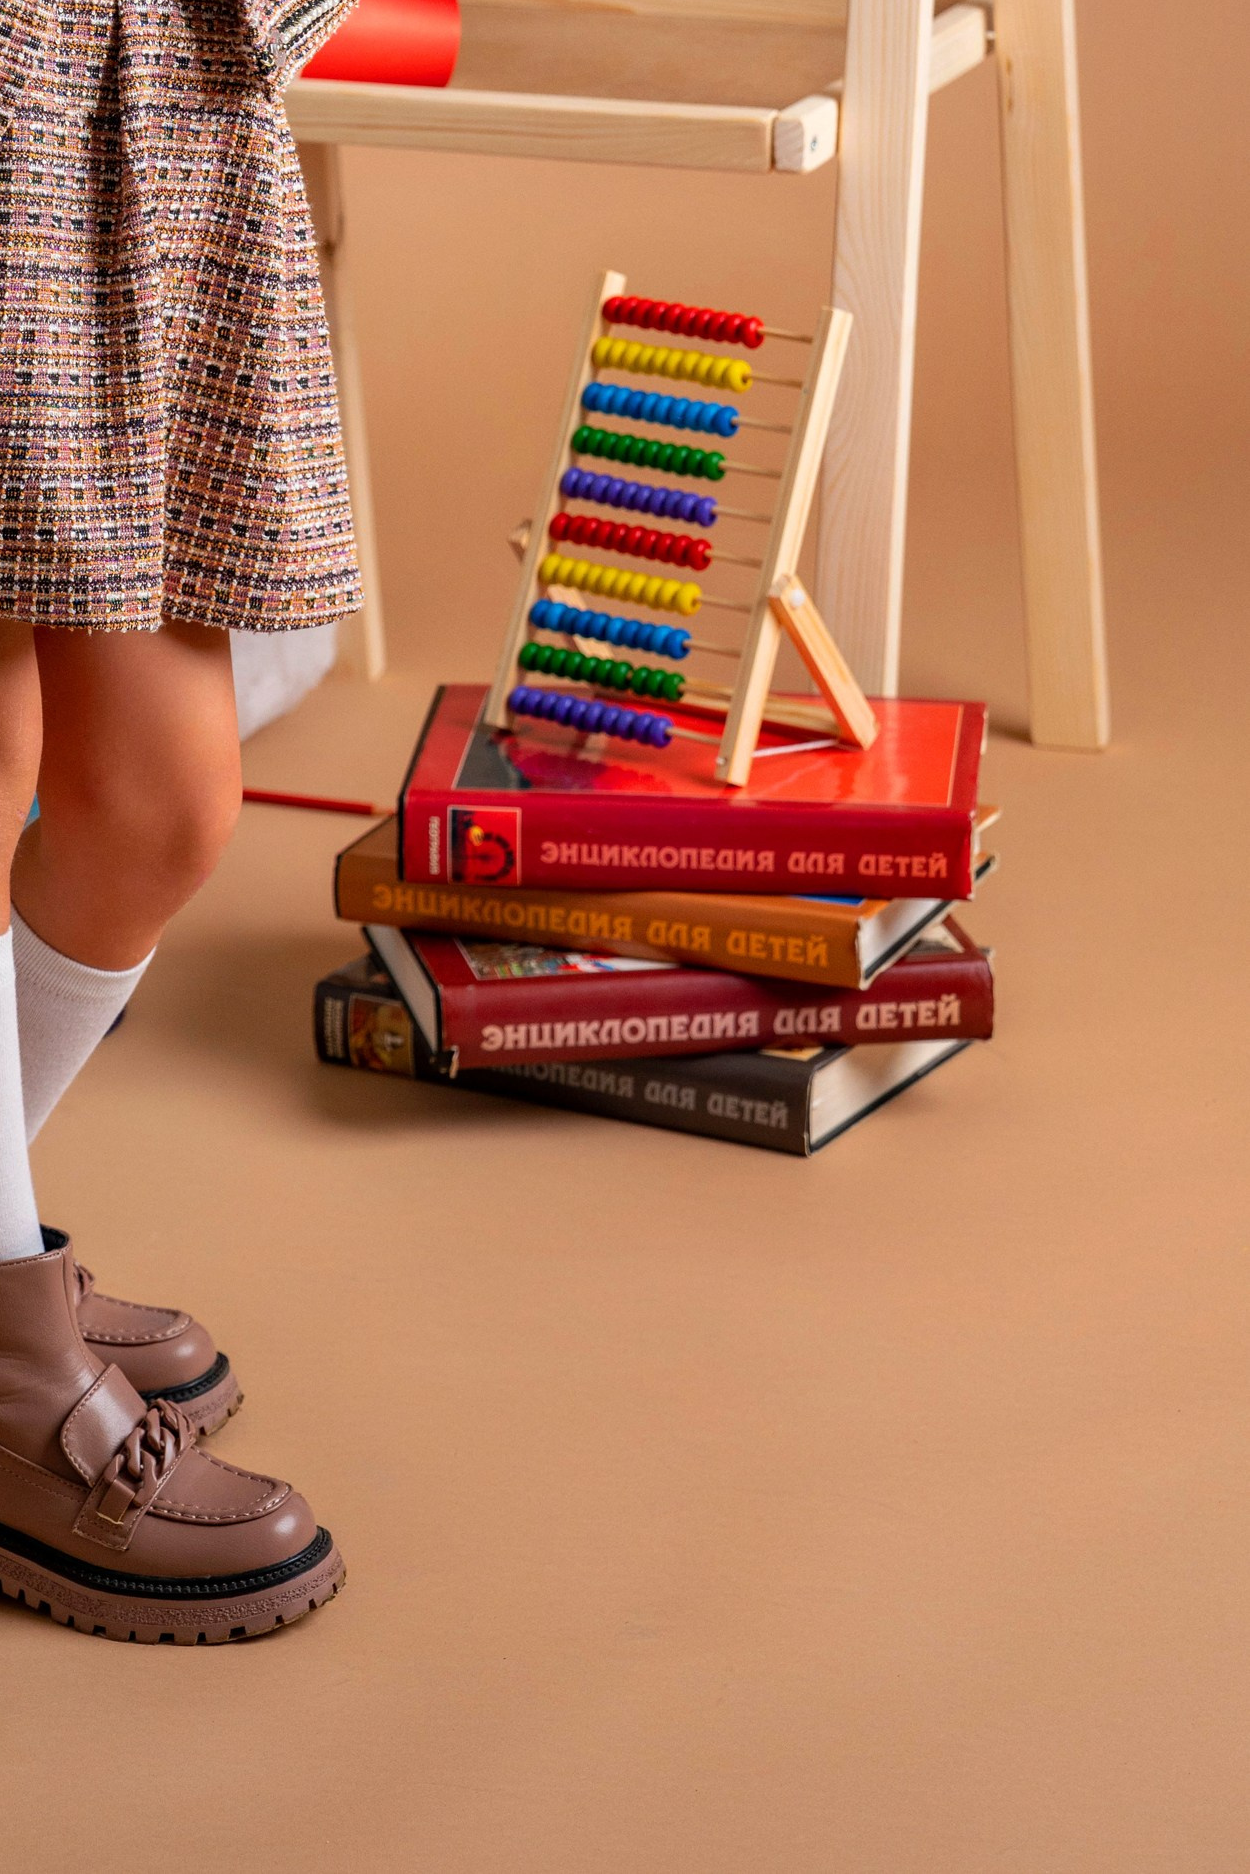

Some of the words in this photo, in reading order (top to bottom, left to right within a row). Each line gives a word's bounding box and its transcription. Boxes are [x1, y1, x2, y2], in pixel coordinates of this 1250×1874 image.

[540, 842, 775, 873] ЭНЦИКЛОПЕДИЯ
[787, 852, 846, 875] ДЛЯ
[858, 852, 948, 879] ДЕТЕЙ
[373, 884, 635, 942] ЭНЦИКЛОПЕДИЯ
[646, 919, 711, 950] ДЛЯ
[725, 929, 829, 967] ДЕТЕЙ
[481, 1012, 761, 1052] ЭНЦИКЛОПЕДИЯ
[773, 1004, 842, 1034] ДЛЯ
[855, 994, 962, 1029] ДЕТЕЙ
[644, 1081, 697, 1112] ДЛЯ
[707, 1092, 789, 1129] ДЕТЕЙ
